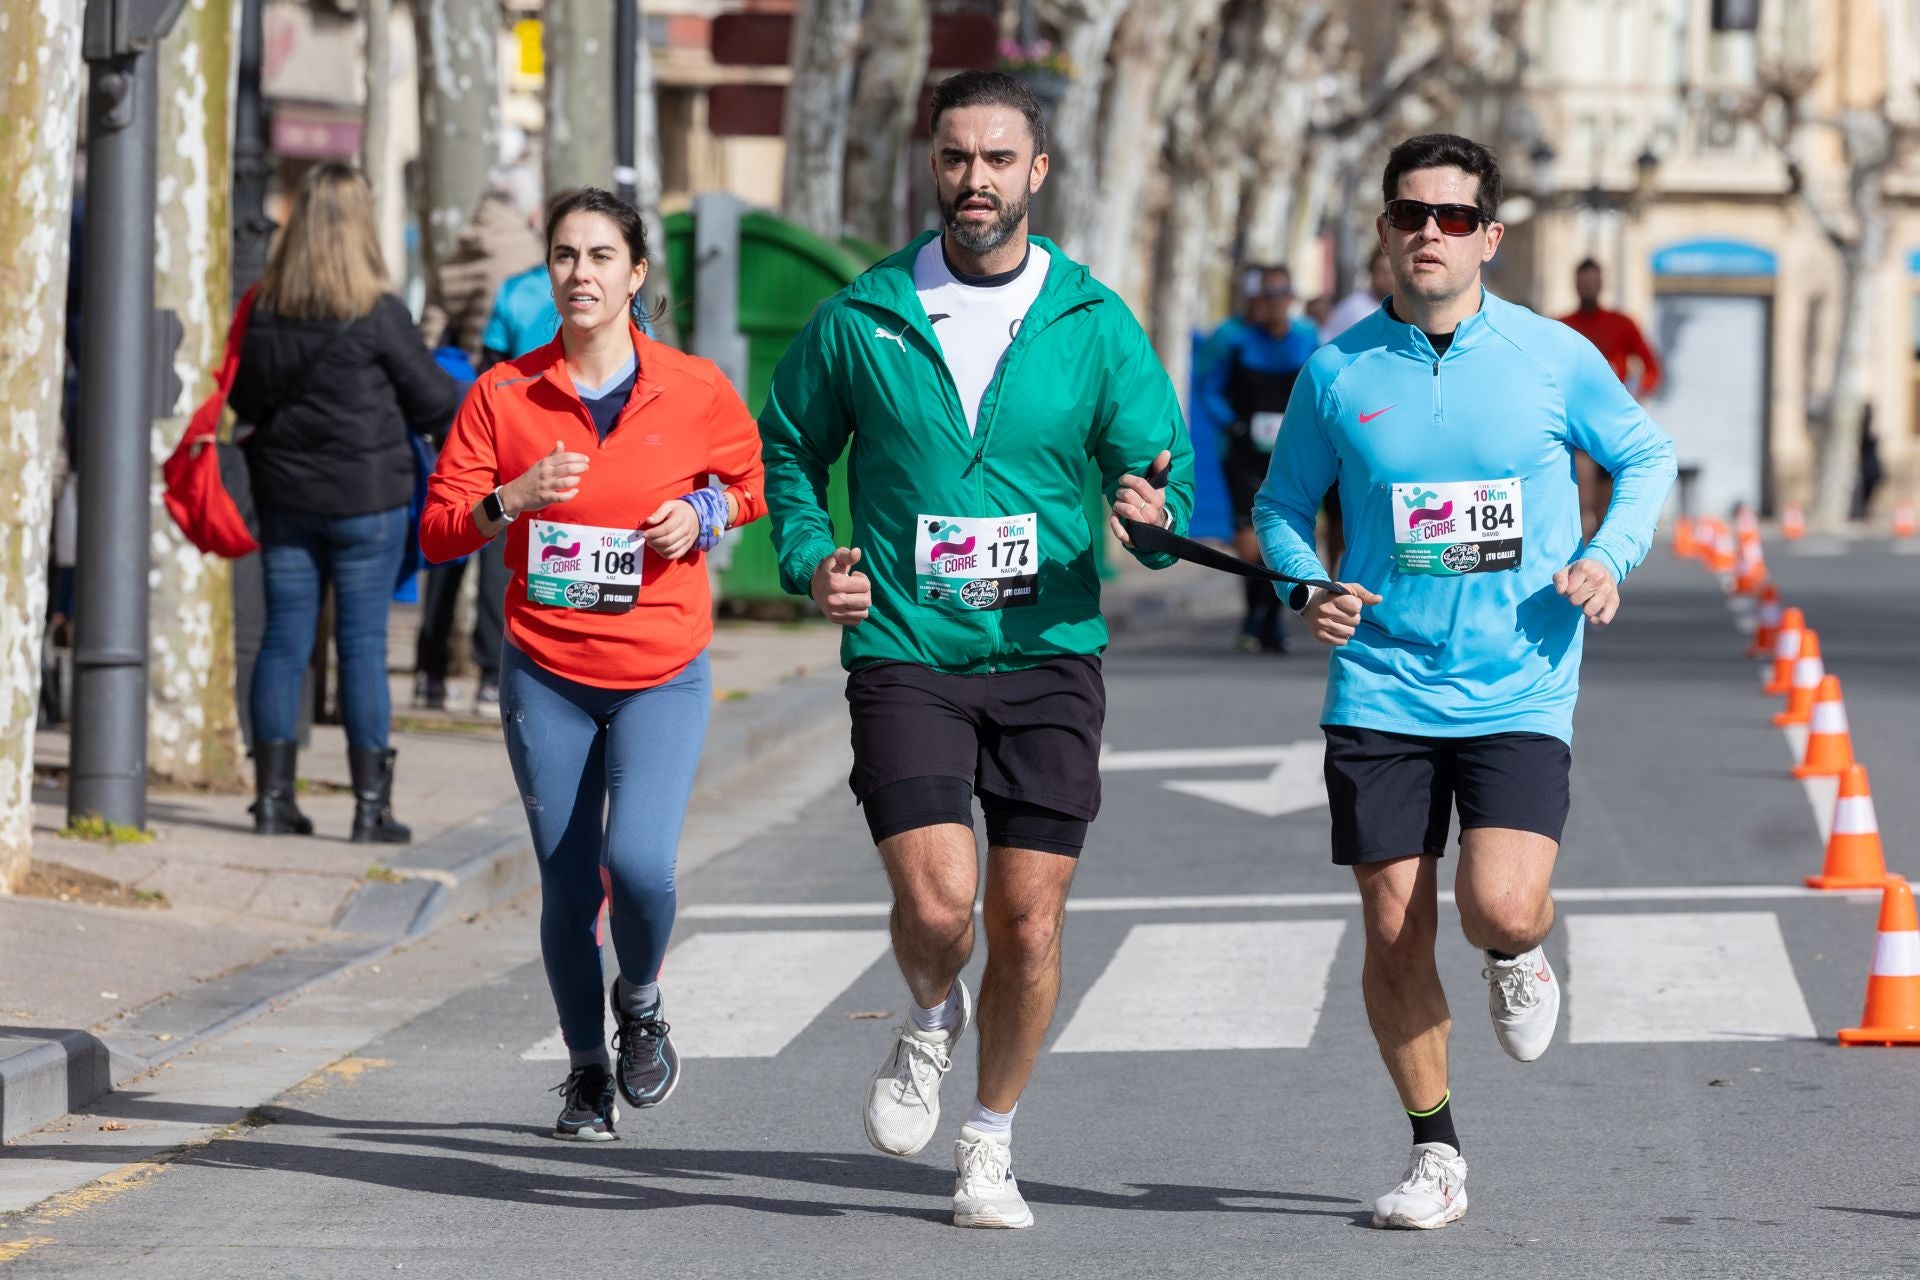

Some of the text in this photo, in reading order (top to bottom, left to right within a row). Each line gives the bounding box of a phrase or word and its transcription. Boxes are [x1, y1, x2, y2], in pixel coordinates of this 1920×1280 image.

[1473, 489, 1507, 502] 10Km
[1465, 503, 1514, 531] 184
[997, 525, 1024, 538] 10Km
[1409, 528, 1422, 543] SE
[1424, 519, 1456, 539] CORRE
[600, 536, 631, 549] 10Km
[988, 539, 1029, 567] 177
[1497, 550, 1515, 560] CALLE!
[540, 559, 581, 575] SE CORRE
[591, 550, 635, 575] 108
[930, 554, 977, 575] SE CORRE
